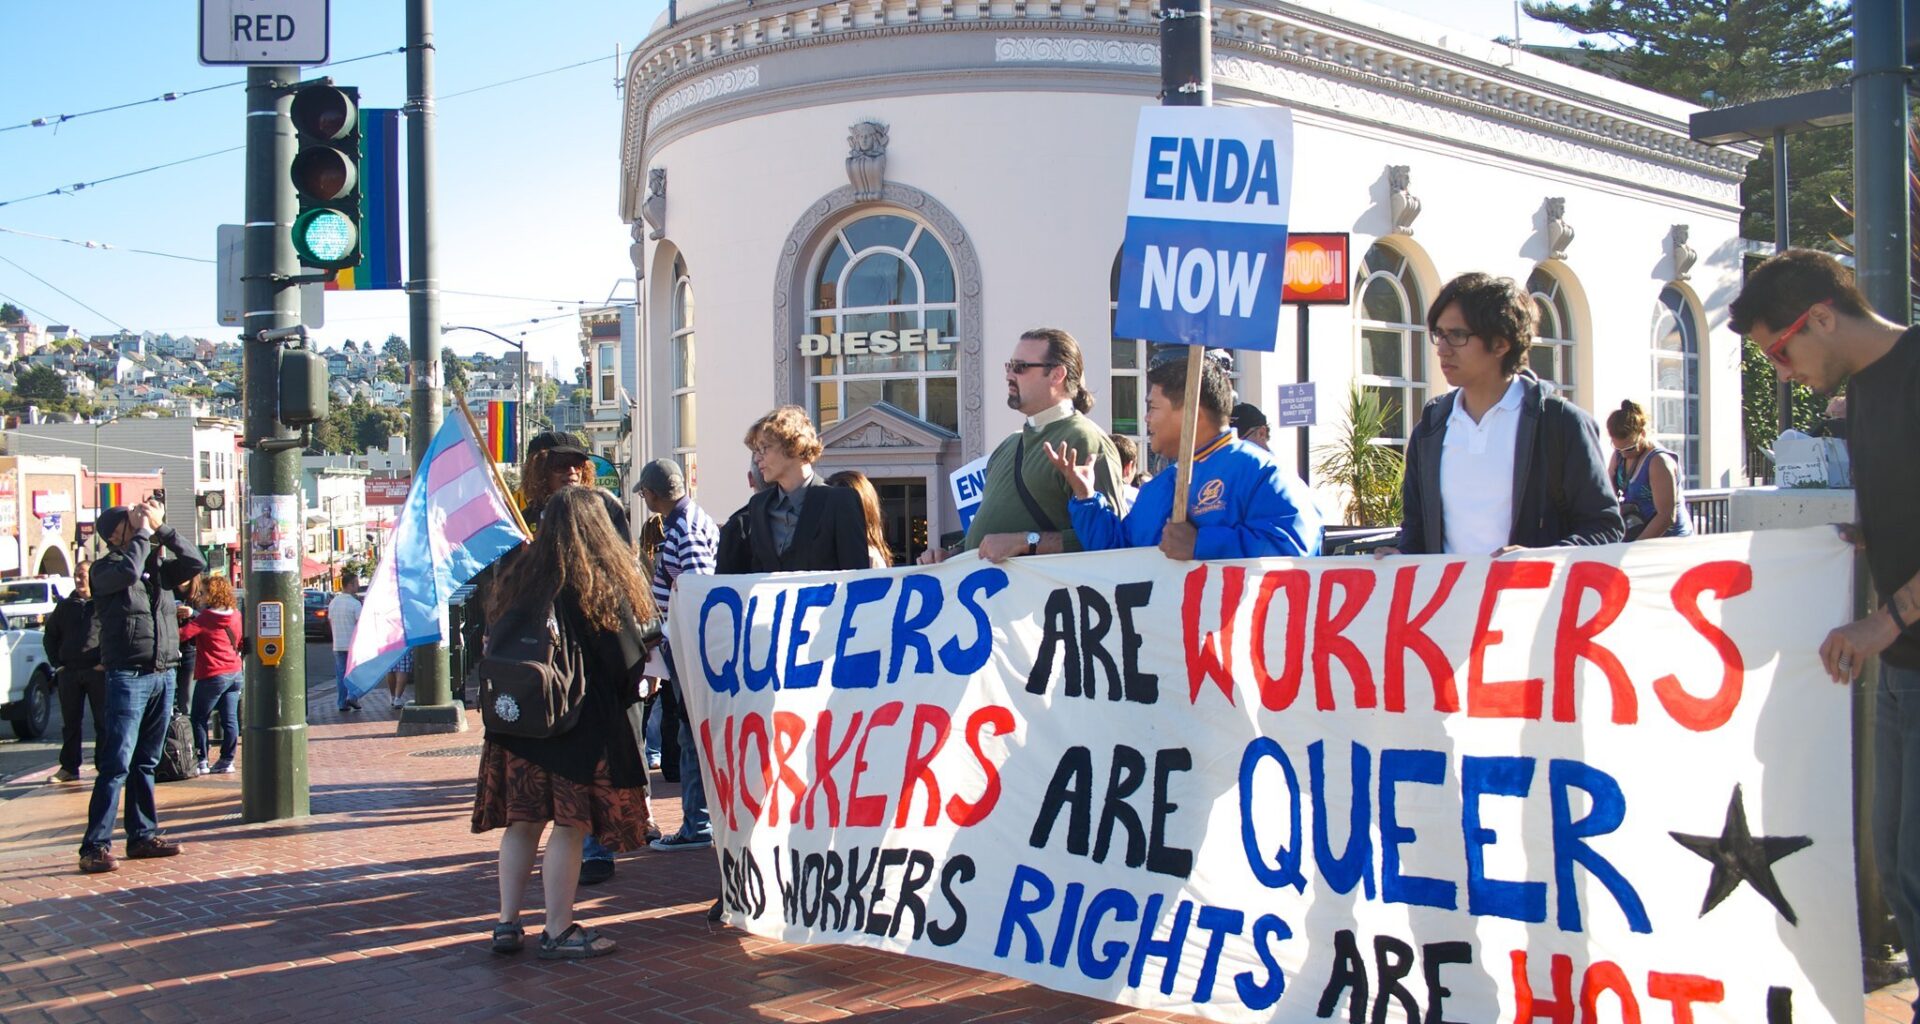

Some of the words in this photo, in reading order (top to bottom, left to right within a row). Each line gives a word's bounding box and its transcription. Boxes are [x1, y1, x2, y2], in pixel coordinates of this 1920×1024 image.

[233, 14, 295, 42] RED
[1144, 136, 1280, 206] ENDA
[1139, 244, 1267, 318] NOW
[800, 328, 951, 357] DIESEL
[699, 567, 1009, 697] QUEERS
[1025, 580, 1159, 704] ARE
[1181, 559, 1753, 732] WORKERS
[700, 701, 1016, 831] WORKERS
[1029, 744, 1192, 878] ARE
[1238, 736, 1653, 934] QUEER
[773, 845, 976, 947] WORKERS
[993, 864, 1293, 1010] RIGHTS
[1316, 929, 1472, 1024] ARE
[1509, 949, 1725, 1024] HOT
